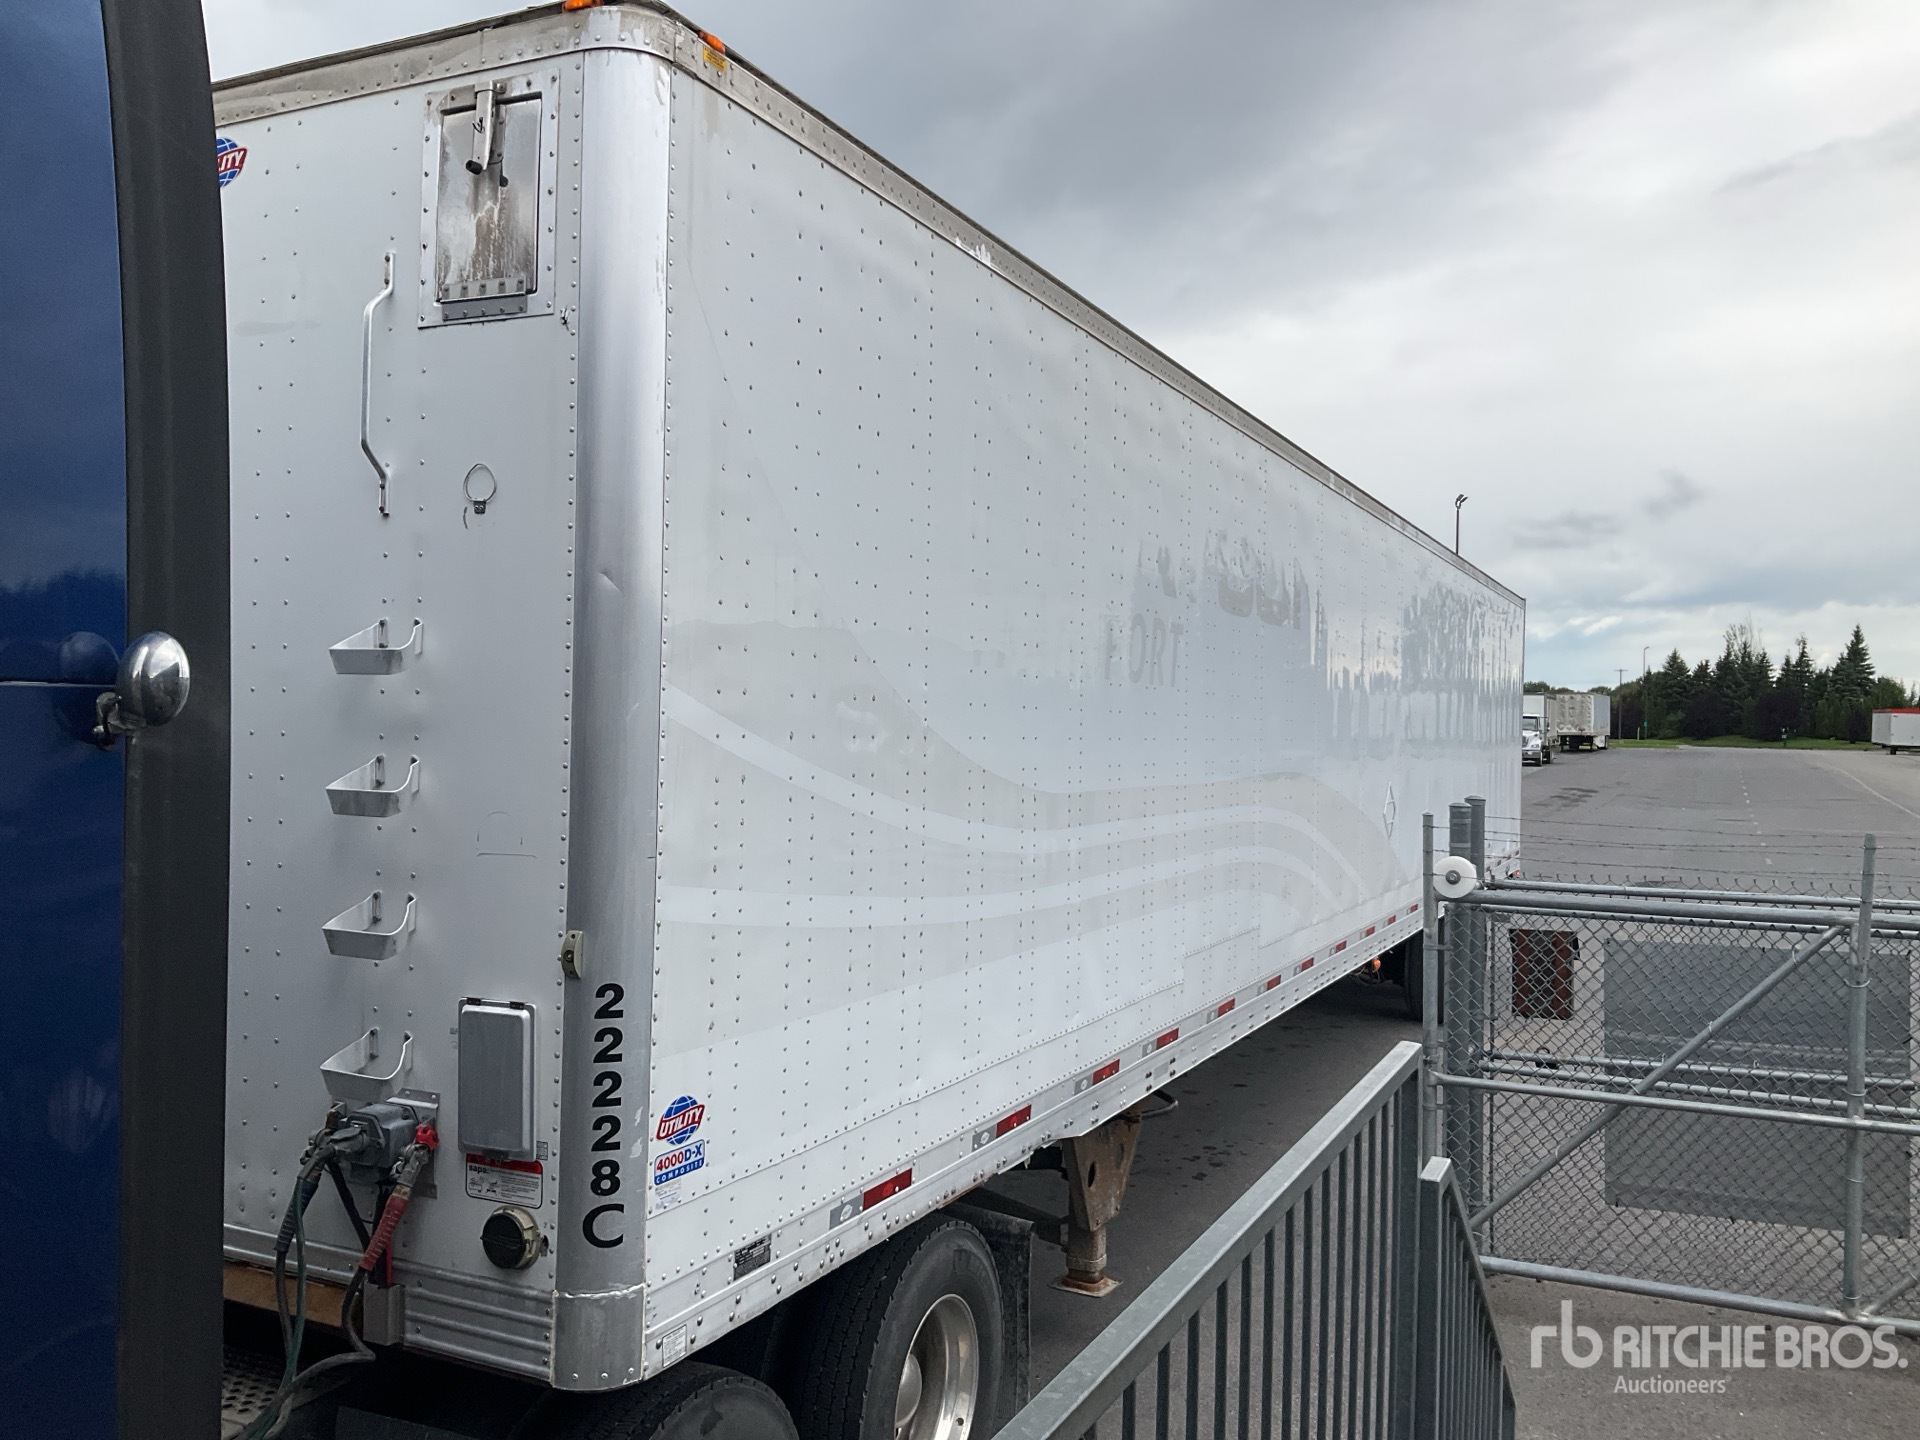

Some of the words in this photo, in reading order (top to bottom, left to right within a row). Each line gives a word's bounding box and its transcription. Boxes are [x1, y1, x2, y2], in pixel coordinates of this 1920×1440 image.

[660, 1106, 703, 1138] UTILITY
[657, 1144, 702, 1171] 4000D-X
[656, 1160, 703, 1184] COMPOSITE
